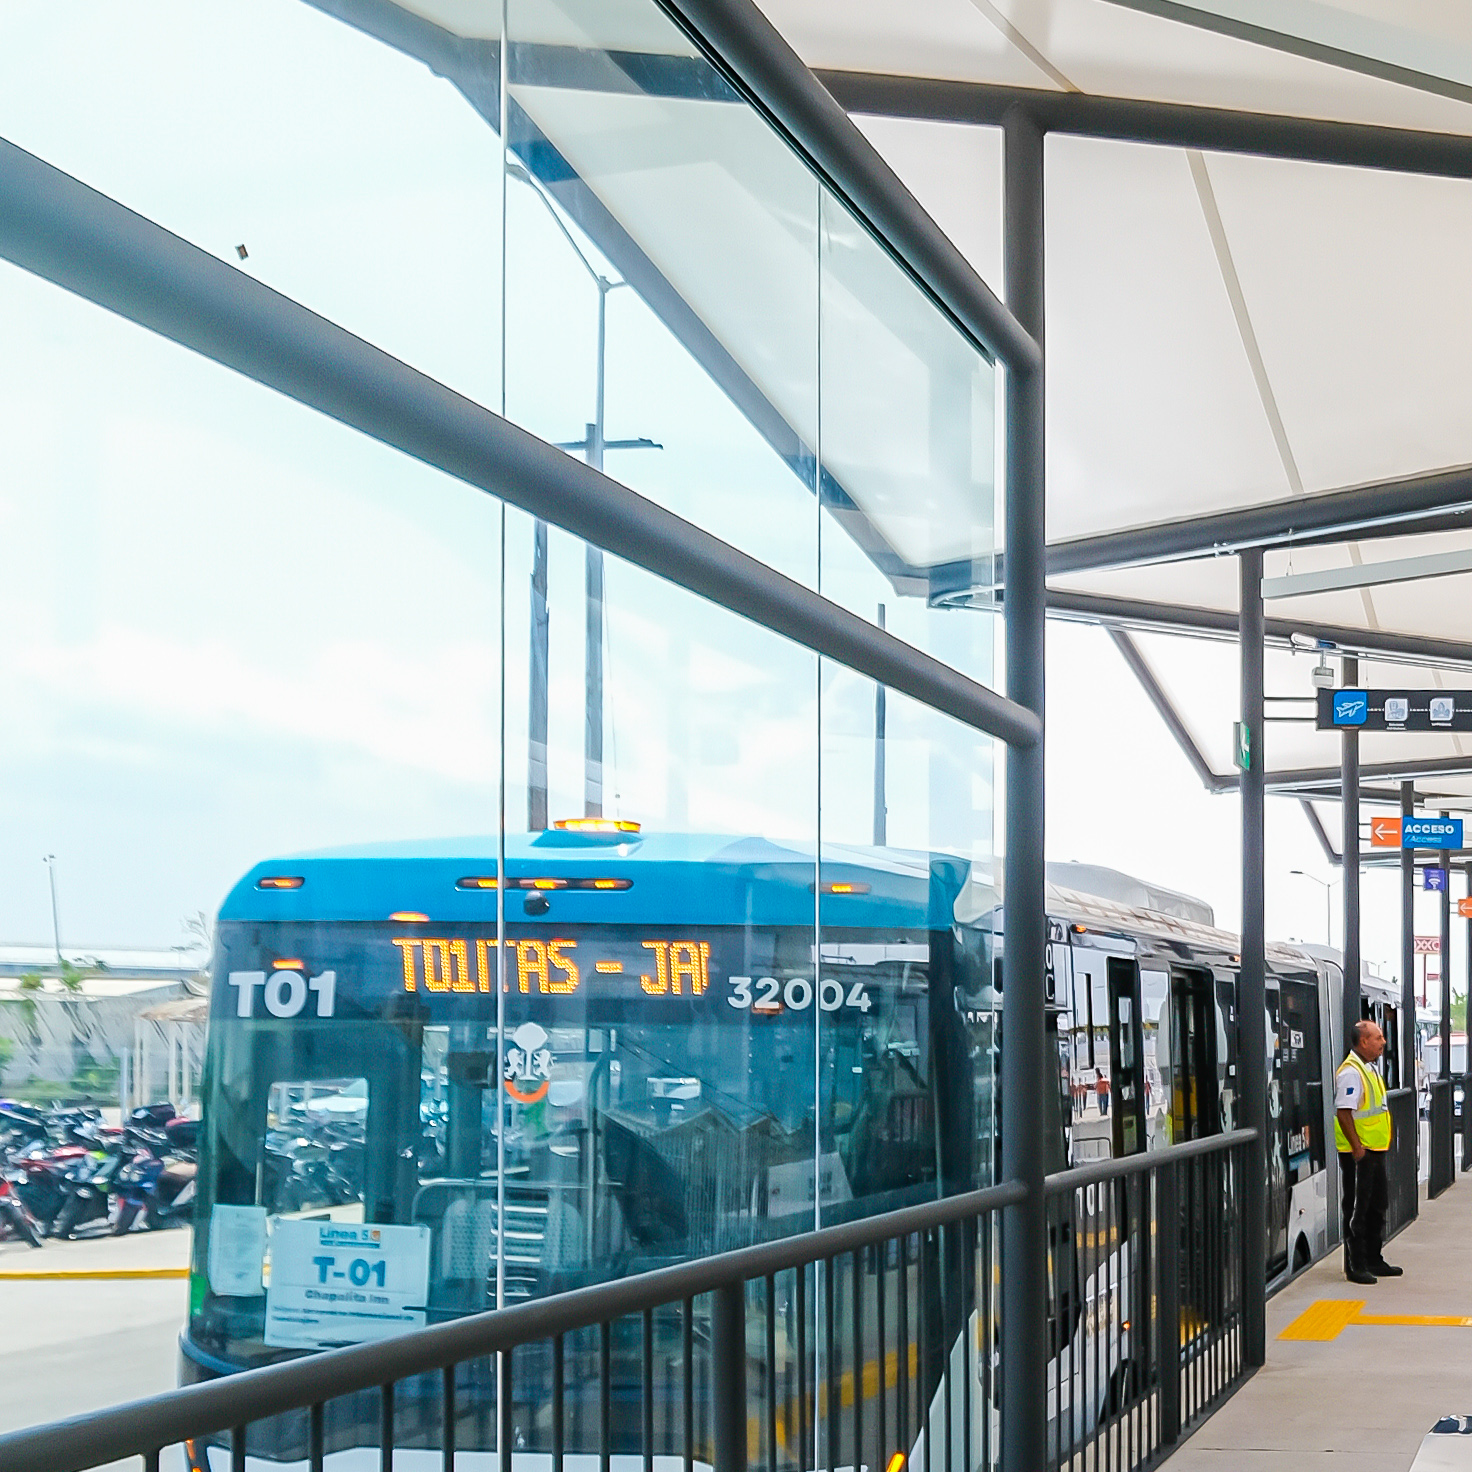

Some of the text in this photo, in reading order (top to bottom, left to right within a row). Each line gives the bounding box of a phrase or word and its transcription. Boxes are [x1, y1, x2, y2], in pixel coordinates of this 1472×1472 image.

[1404, 824, 1455, 835] ACCESO
[727, 976, 872, 1013] 32004
[313, 1256, 386, 1287] T-01
